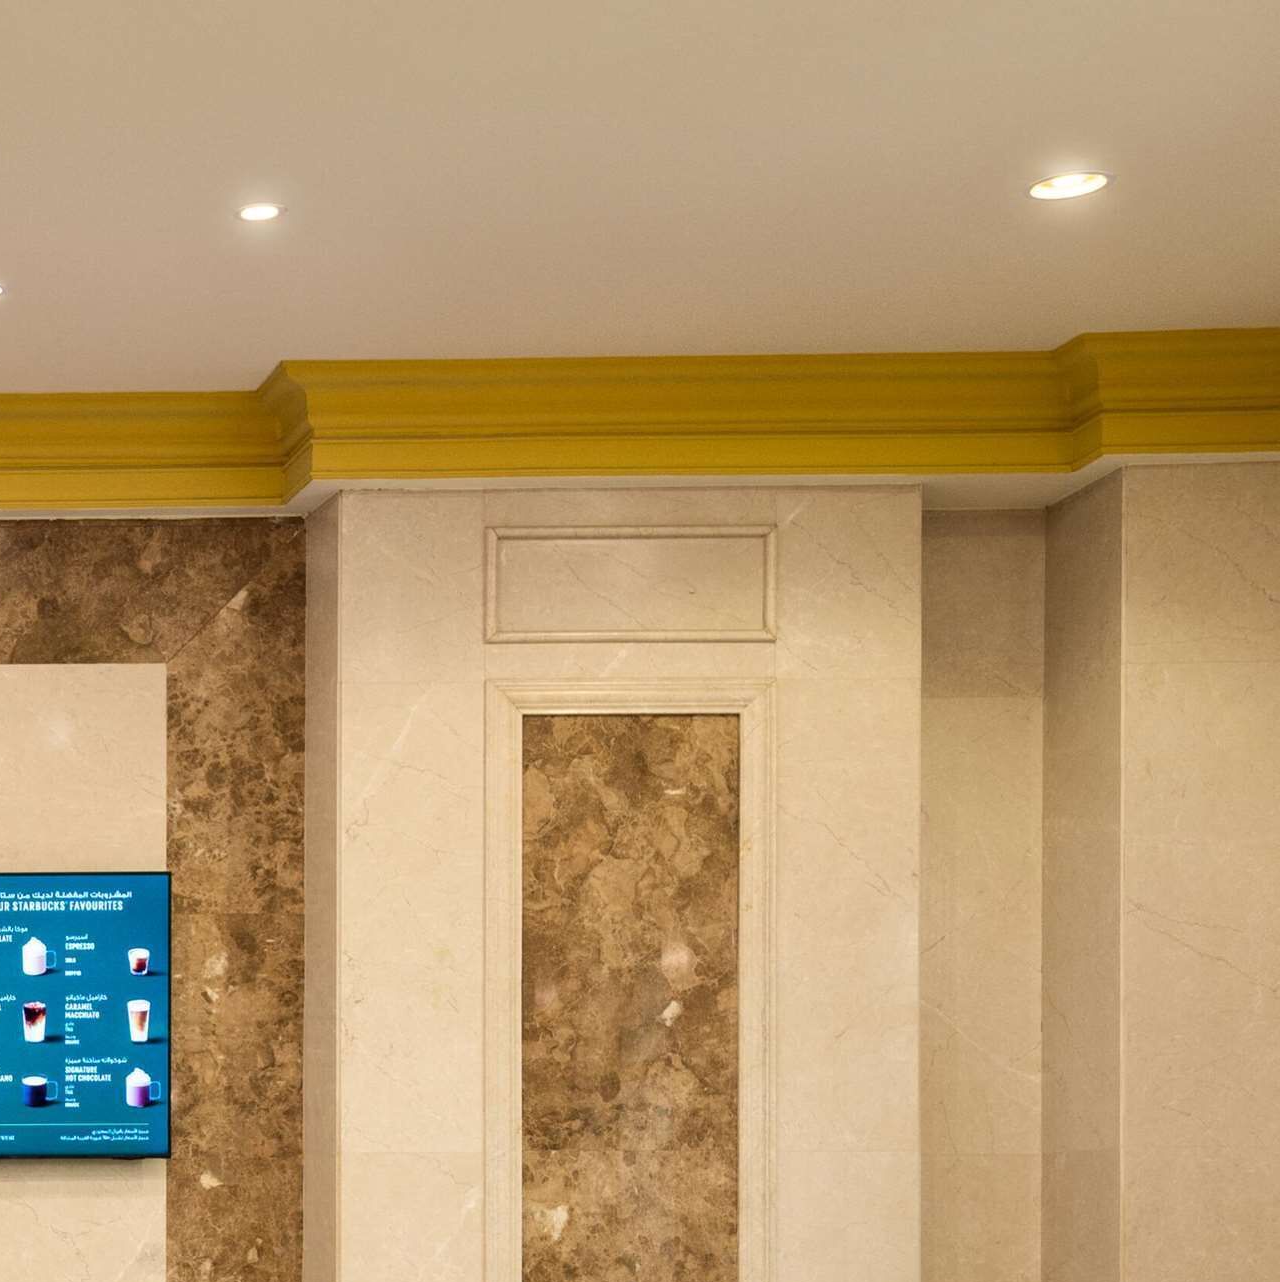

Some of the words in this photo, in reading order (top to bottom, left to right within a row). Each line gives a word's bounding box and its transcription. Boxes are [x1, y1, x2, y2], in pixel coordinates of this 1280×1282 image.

[17, 892, 31, 900] من
[55, 891, 89, 899] المفضلة
[90, 891, 133, 899] المشروبات
[69, 900, 124, 911] FAVOURITES
[65, 942, 95, 950] ESPRESSO
[65, 1003, 93, 1011] CARAMEL
[65, 1011, 100, 1019] MACCHIATO
[65, 1066, 98, 1074] SIGNATURE
[65, 1074, 77, 1082] HOT
[78, 1074, 112, 1082] CHOCOLATE
